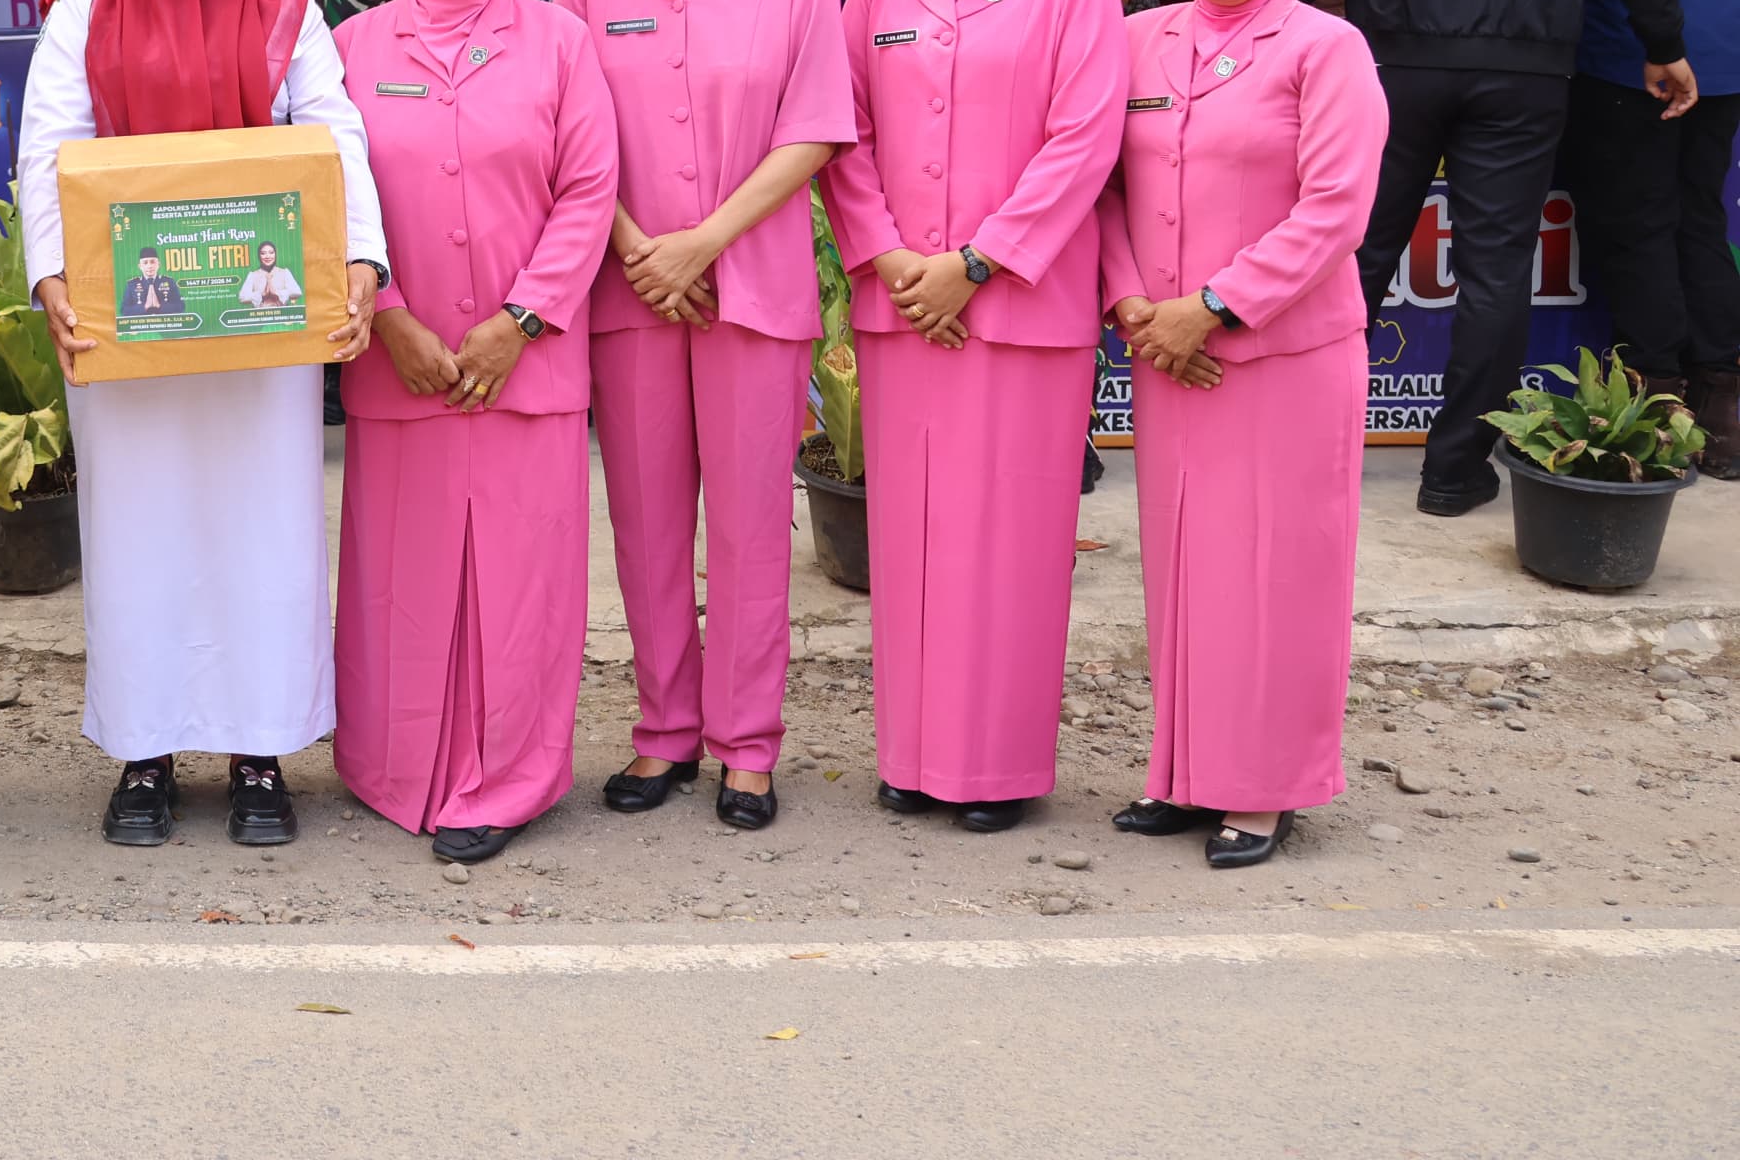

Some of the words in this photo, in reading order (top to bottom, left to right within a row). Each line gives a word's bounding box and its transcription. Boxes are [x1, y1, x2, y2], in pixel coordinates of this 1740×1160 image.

[226, 200, 256, 208] SELATAN
[156, 232, 198, 245] Selamat
[200, 228, 225, 243] Hari
[227, 228, 256, 240] Raya
[165, 247, 202, 272] IDUL
[208, 244, 250, 270] FITRI
